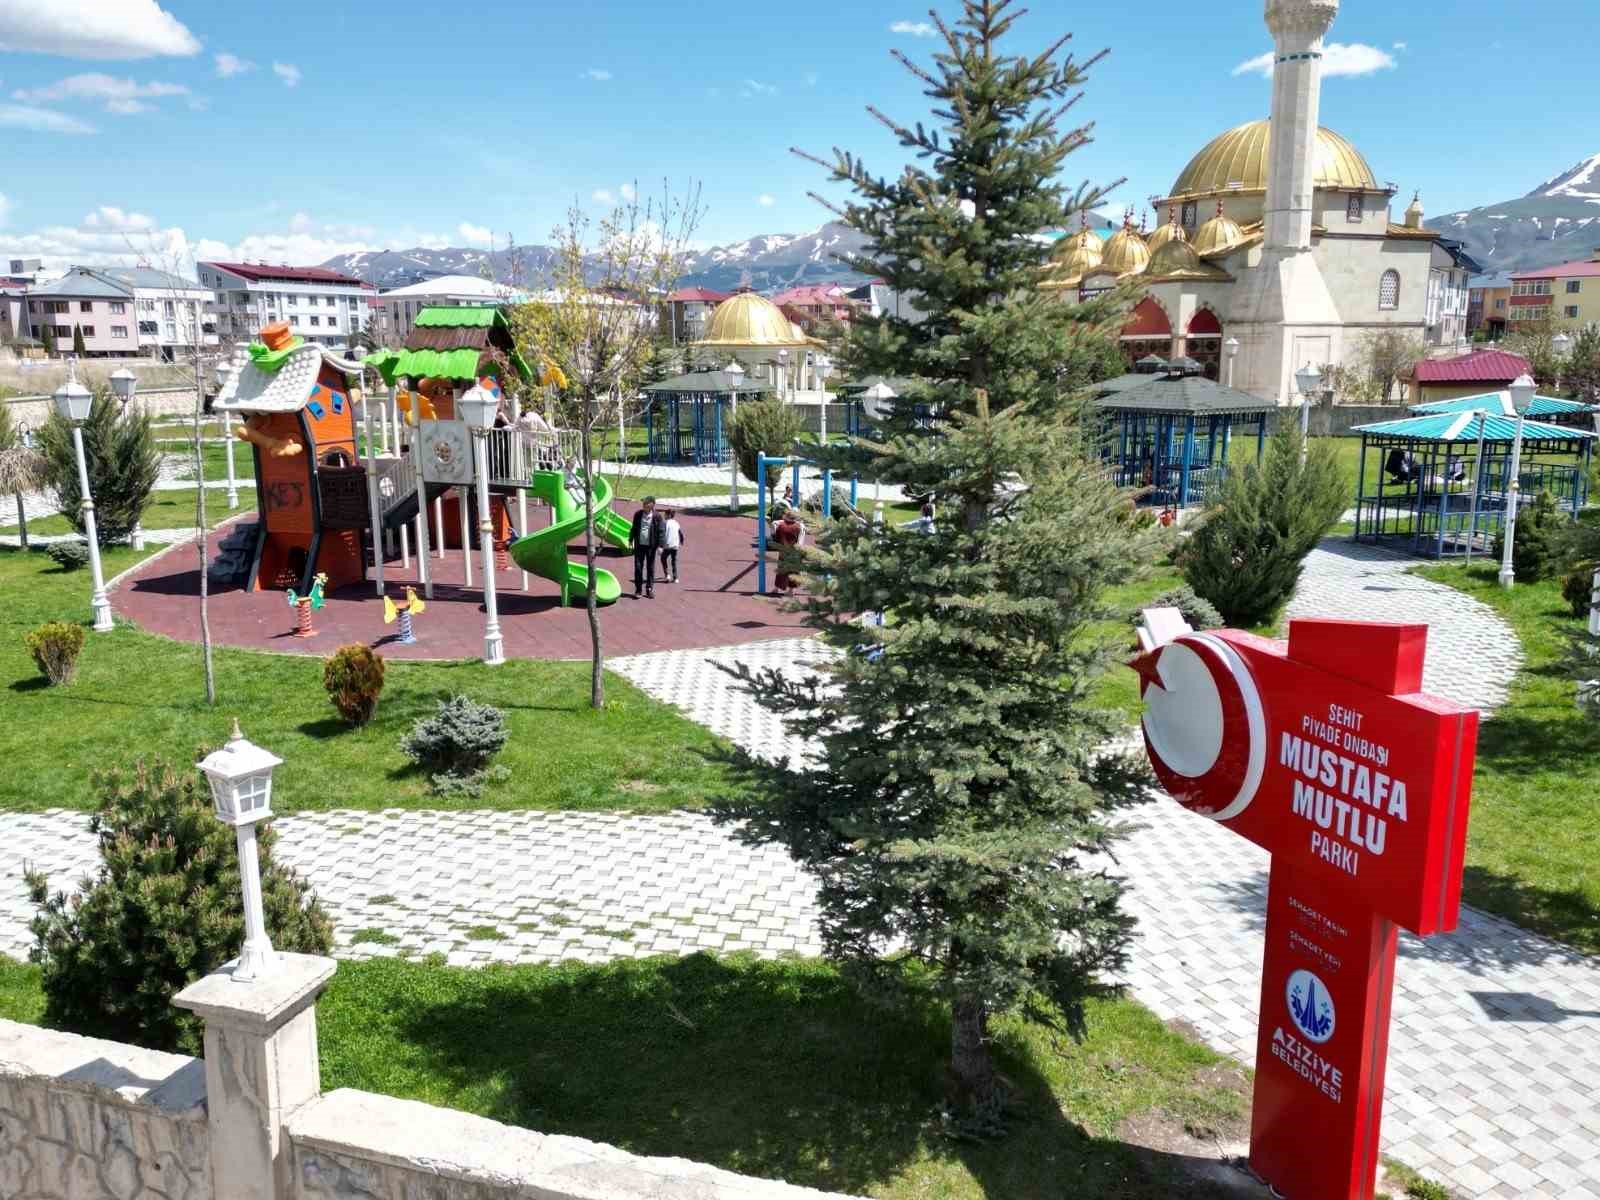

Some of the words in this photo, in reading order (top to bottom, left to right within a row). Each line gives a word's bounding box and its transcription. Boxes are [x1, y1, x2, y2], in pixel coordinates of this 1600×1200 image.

[1303, 713, 1341, 746] PİYADE
[1343, 732, 1389, 768] ONBAŞI
[1280, 731, 1408, 822] MUSTAFA
[1292, 778, 1387, 856] MUTLU
[1311, 830, 1359, 876] PARKI
[1271, 1042, 1342, 1104] BELEDİYESİ
[1273, 1026, 1343, 1089] AZİZİYE
